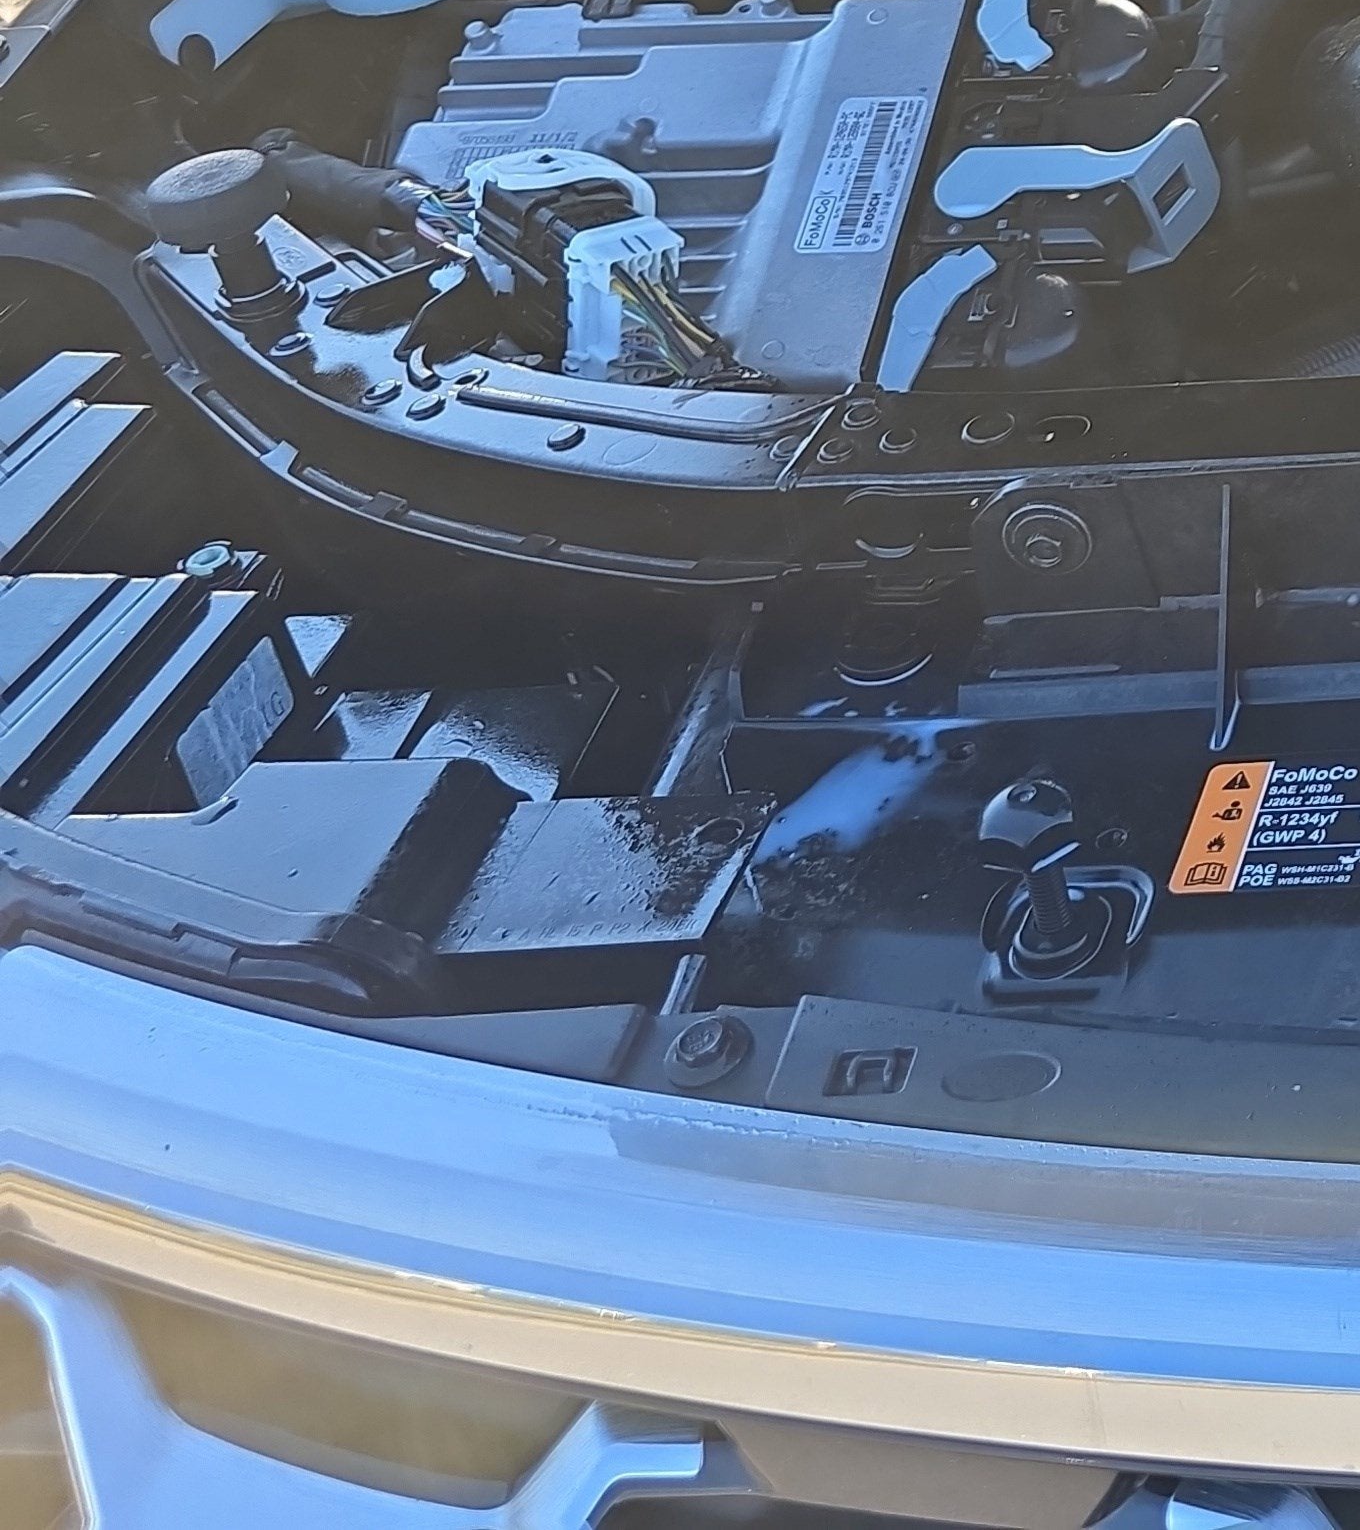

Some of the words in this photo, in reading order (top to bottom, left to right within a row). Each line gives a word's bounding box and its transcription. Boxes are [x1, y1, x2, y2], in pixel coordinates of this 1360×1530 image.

[861, 192, 882, 229] BOSCH
[803, 198, 831, 247] FoMoCo
[1271, 766, 1358, 783] FoMoCo
[1268, 785, 1298, 795] SAE
[1300, 783, 1333, 794] J639
[1263, 796, 1303, 807] J2842
[1305, 794, 1344, 805] J2845
[1258, 810, 1339, 827] R-1234yf
[1252, 830, 1306, 846] (GWP
[1308, 829, 1326, 844] 4)
[1242, 863, 1278, 875] PAG
[1238, 875, 1275, 887] POE
